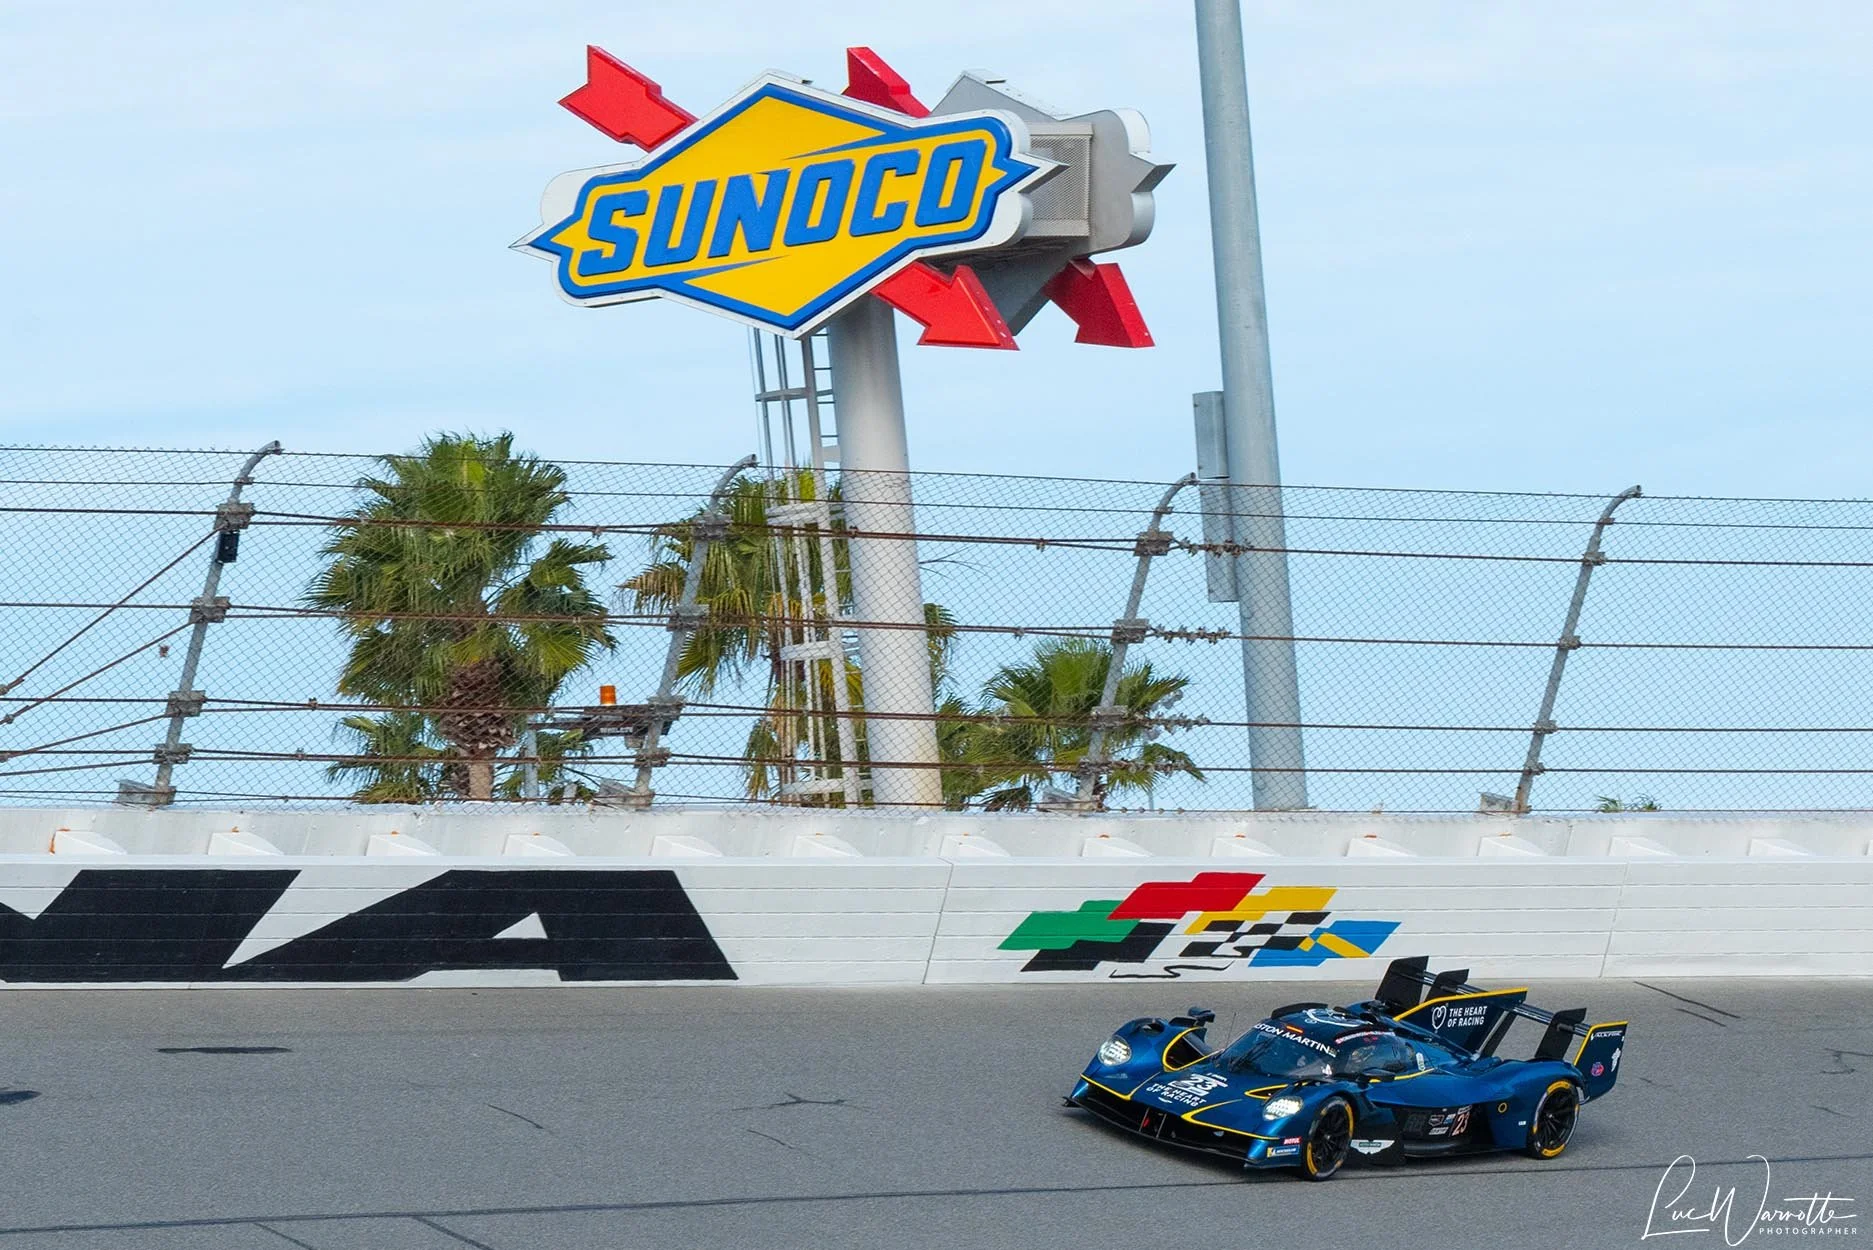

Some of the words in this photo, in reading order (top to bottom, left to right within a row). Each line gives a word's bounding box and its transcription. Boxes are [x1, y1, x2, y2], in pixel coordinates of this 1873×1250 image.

[579, 138, 988, 277] SUNOCO
[1449, 1007, 1463, 1017] THE
[1464, 1005, 1488, 1016] HEART
[1447, 1018, 1457, 1028] OF
[1458, 1016, 1485, 1027] RACING
[1282, 1031, 1330, 1055] MARTIN
[1182, 1075, 1217, 1091] 23
[1152, 1083, 1172, 1092] THE
[1173, 1089, 1207, 1104] HEART
[1161, 1091, 1199, 1107] RACING
[1451, 1112, 1470, 1137] 23
